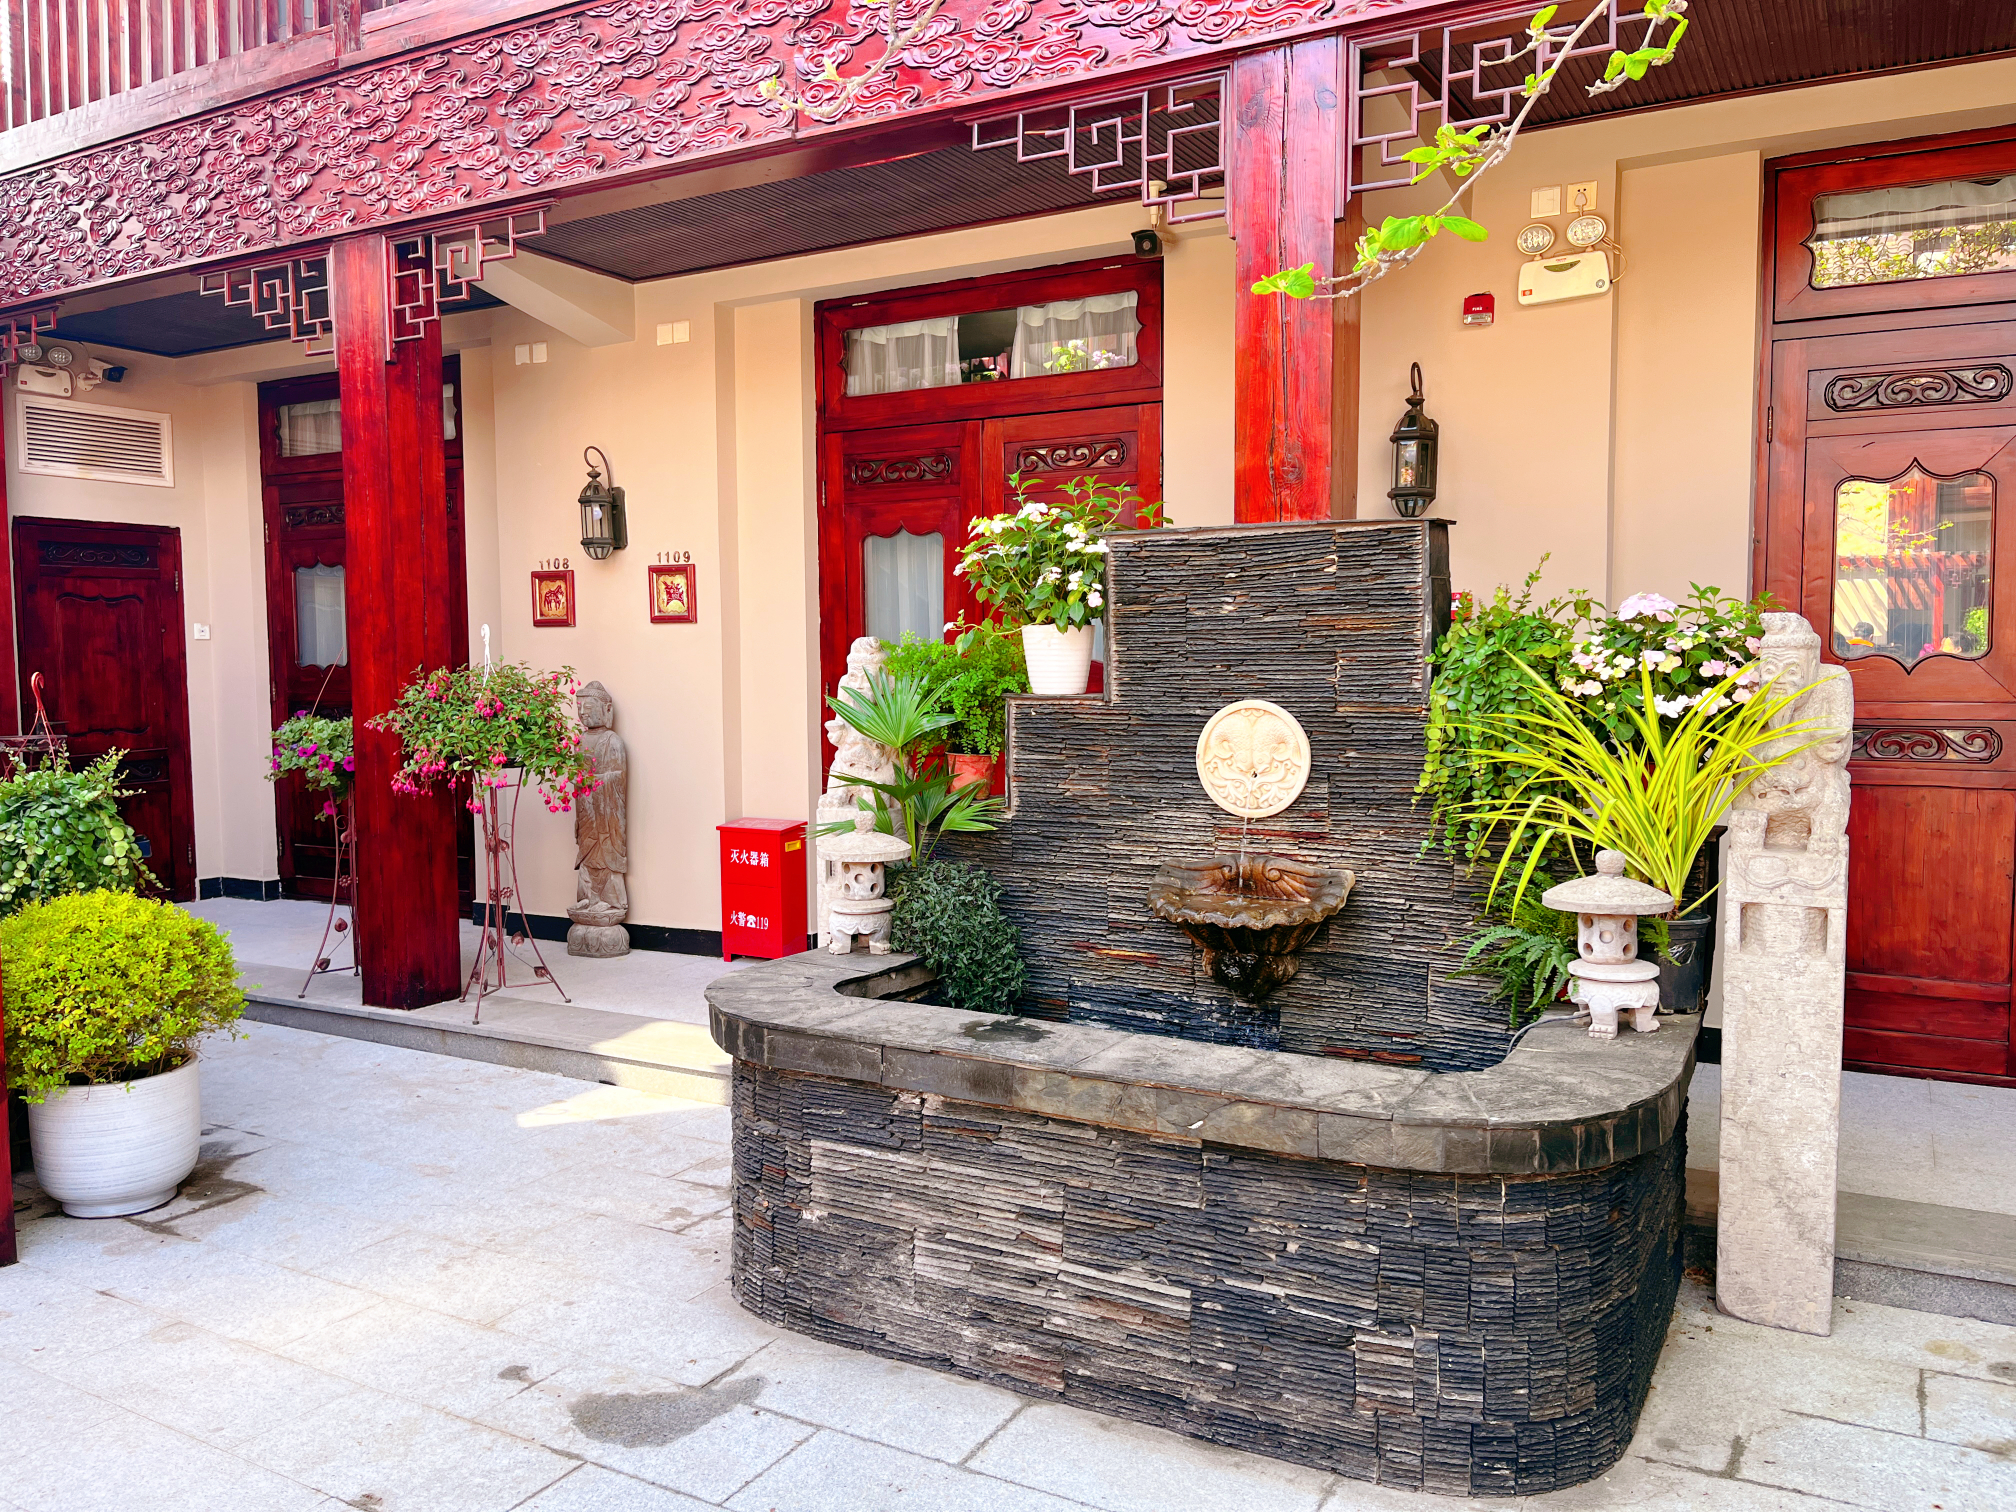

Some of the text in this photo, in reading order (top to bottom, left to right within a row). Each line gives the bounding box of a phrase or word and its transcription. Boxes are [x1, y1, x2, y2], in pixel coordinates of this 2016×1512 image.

[539, 557, 570, 571] 1108
[656, 551, 691, 564] 1109
[730, 848, 770, 868] 灭火器箱
